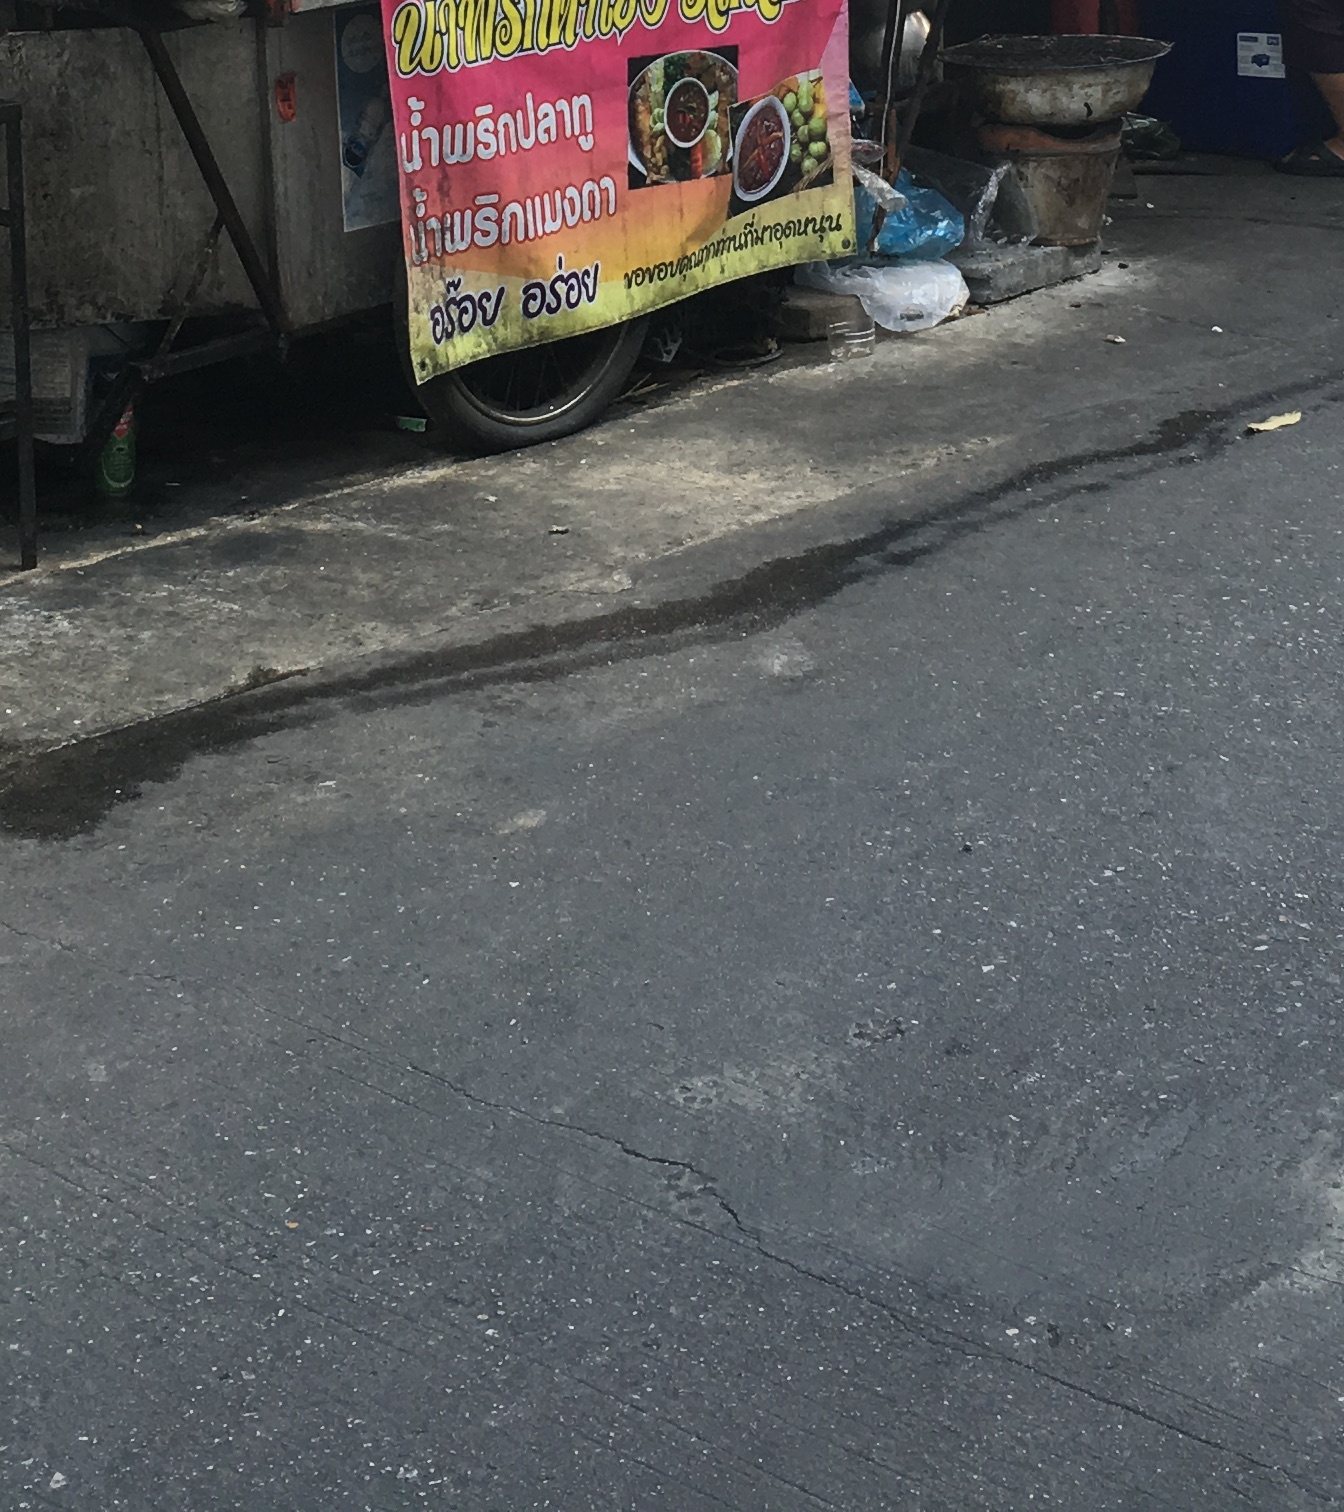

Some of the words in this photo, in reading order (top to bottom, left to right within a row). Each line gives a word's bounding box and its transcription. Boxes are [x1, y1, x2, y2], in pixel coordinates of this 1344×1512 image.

[401, 92, 594, 173] น้ำพริกปลาทู
[409, 176, 616, 265] น้ำพริกแมงดา
[521, 255, 599, 319] อร่อย
